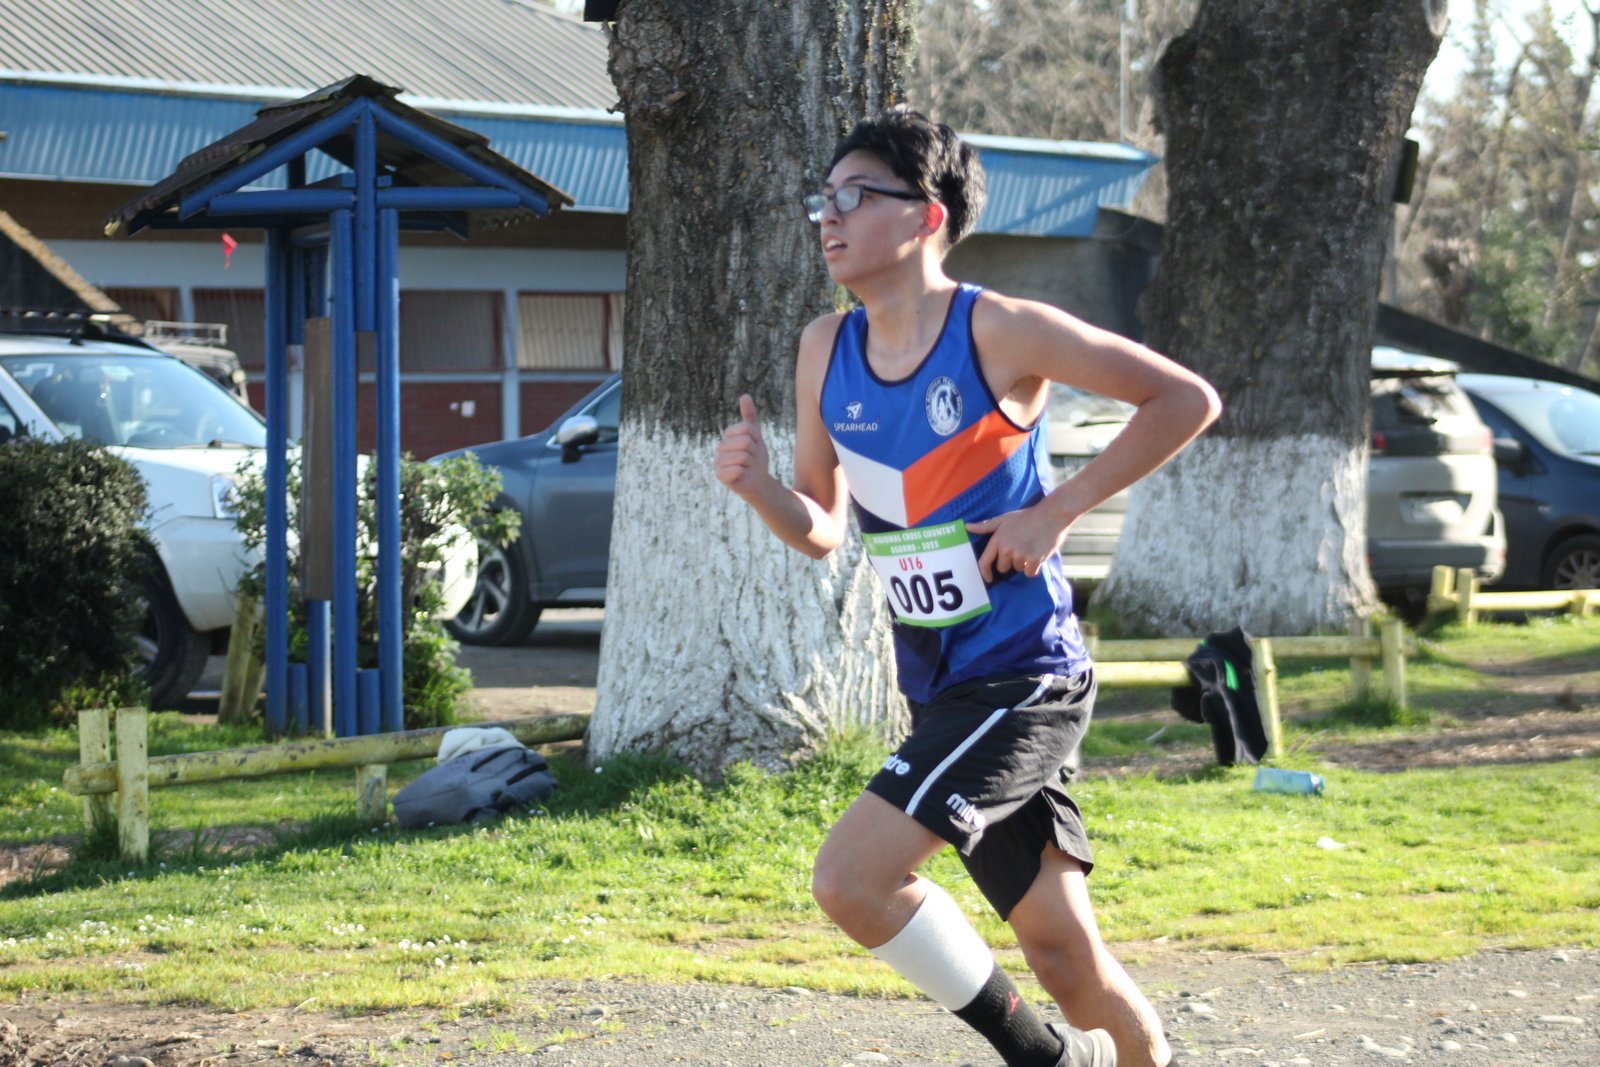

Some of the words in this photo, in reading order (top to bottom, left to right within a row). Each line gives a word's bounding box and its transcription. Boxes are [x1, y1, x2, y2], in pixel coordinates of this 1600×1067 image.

[833, 422, 878, 432] SPEARHEAD
[872, 534, 901, 544] REGIONAL
[902, 531, 922, 541] CROSS
[923, 525, 956, 538] COUNTRY
[890, 544, 916, 554] OSORNO
[921, 540, 940, 551] 2025
[898, 556, 923, 571] U16
[890, 569, 963, 614] 005
